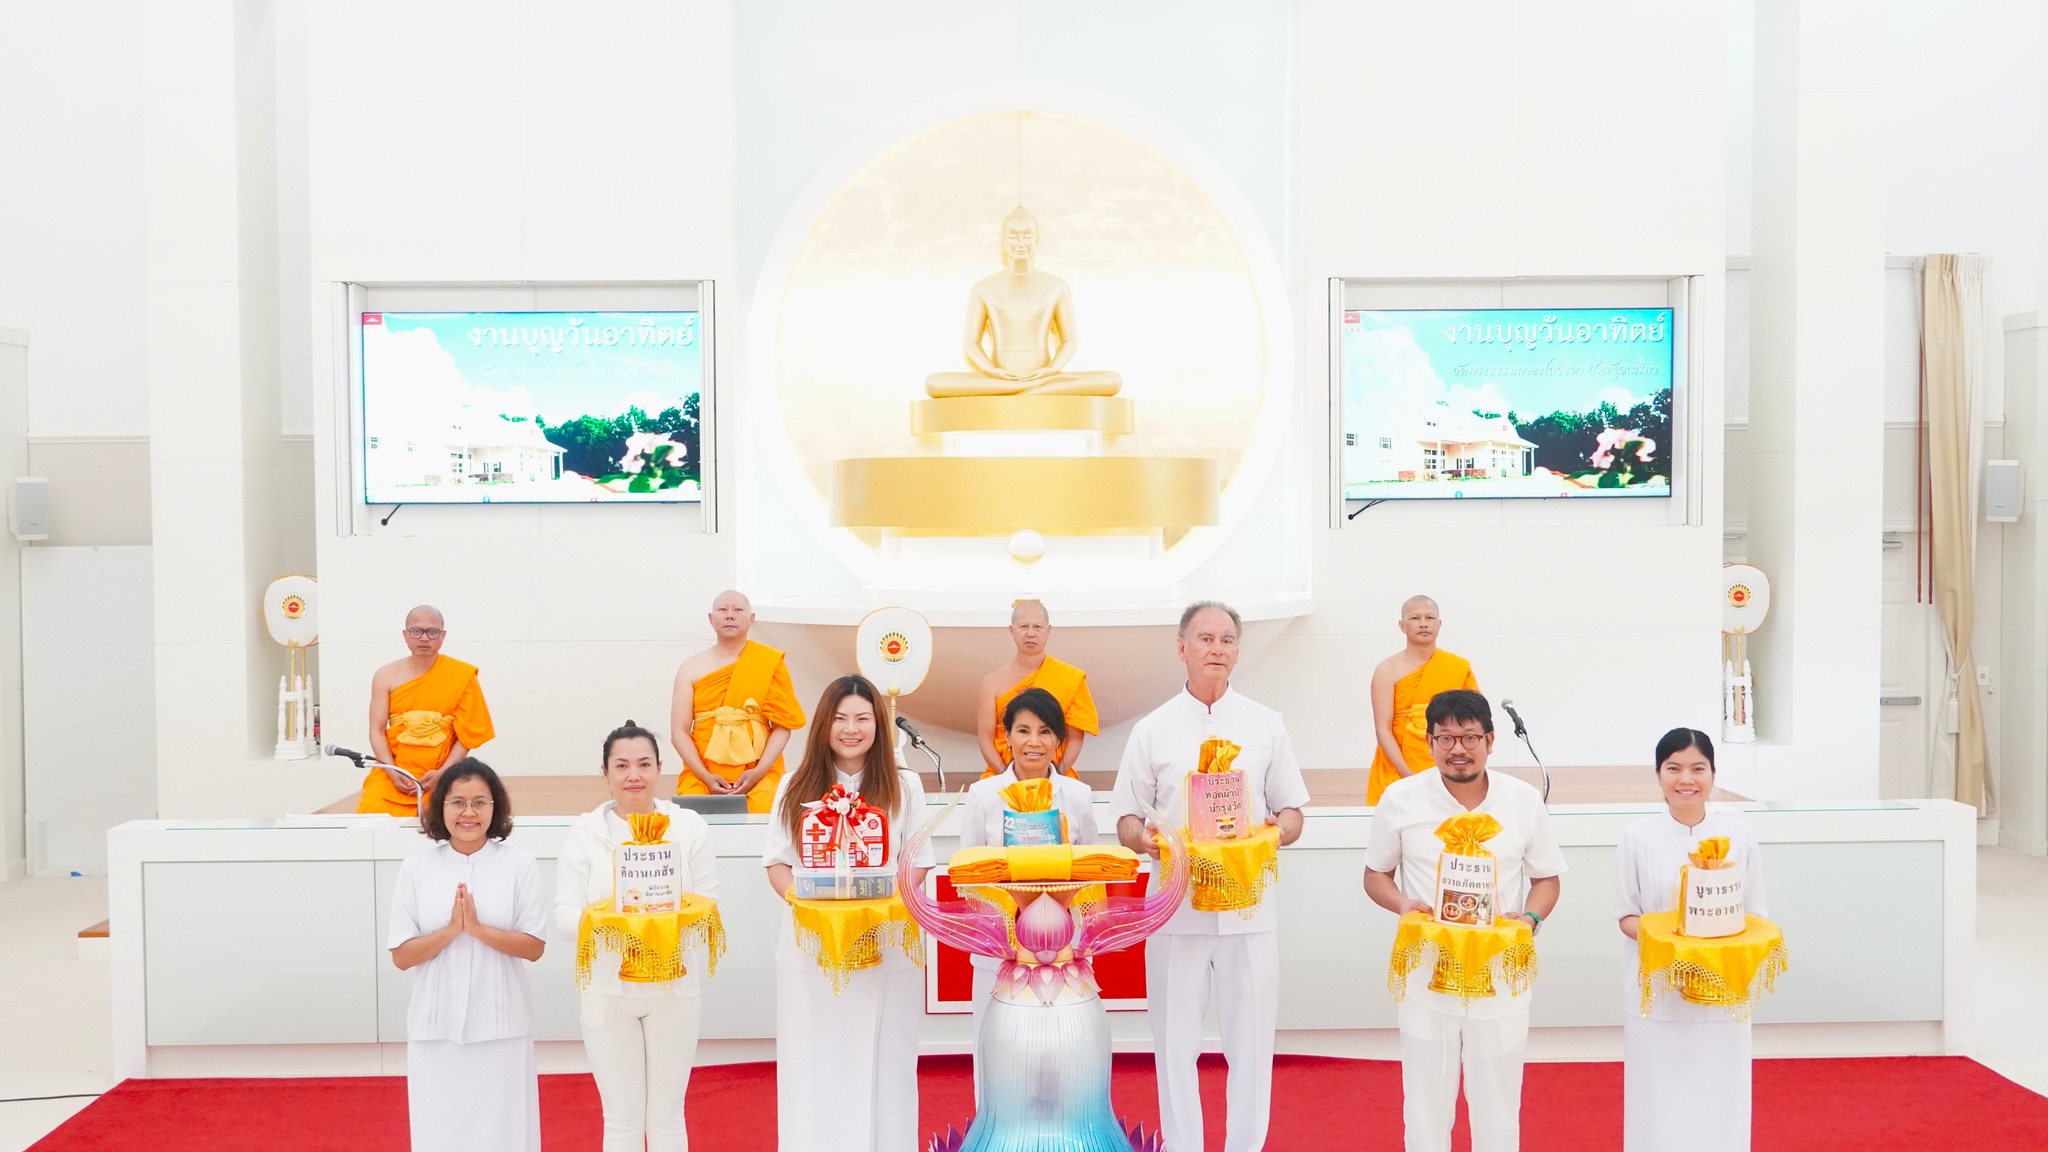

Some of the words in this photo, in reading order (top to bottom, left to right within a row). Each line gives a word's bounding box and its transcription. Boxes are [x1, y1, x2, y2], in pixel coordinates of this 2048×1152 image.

[467, 315, 694, 354] งานบุญวันอาทิตย์
[1443, 311, 1666, 351] งานบุญวันอาทิตย์
[1208, 777, 1240, 786] ประธาน
[1209, 801, 1242, 815] บำรุงวัด
[624, 847, 672, 861] ประธาน
[621, 864, 675, 878] คิลานเภสัช
[1450, 857, 1491, 873] ประธาน
